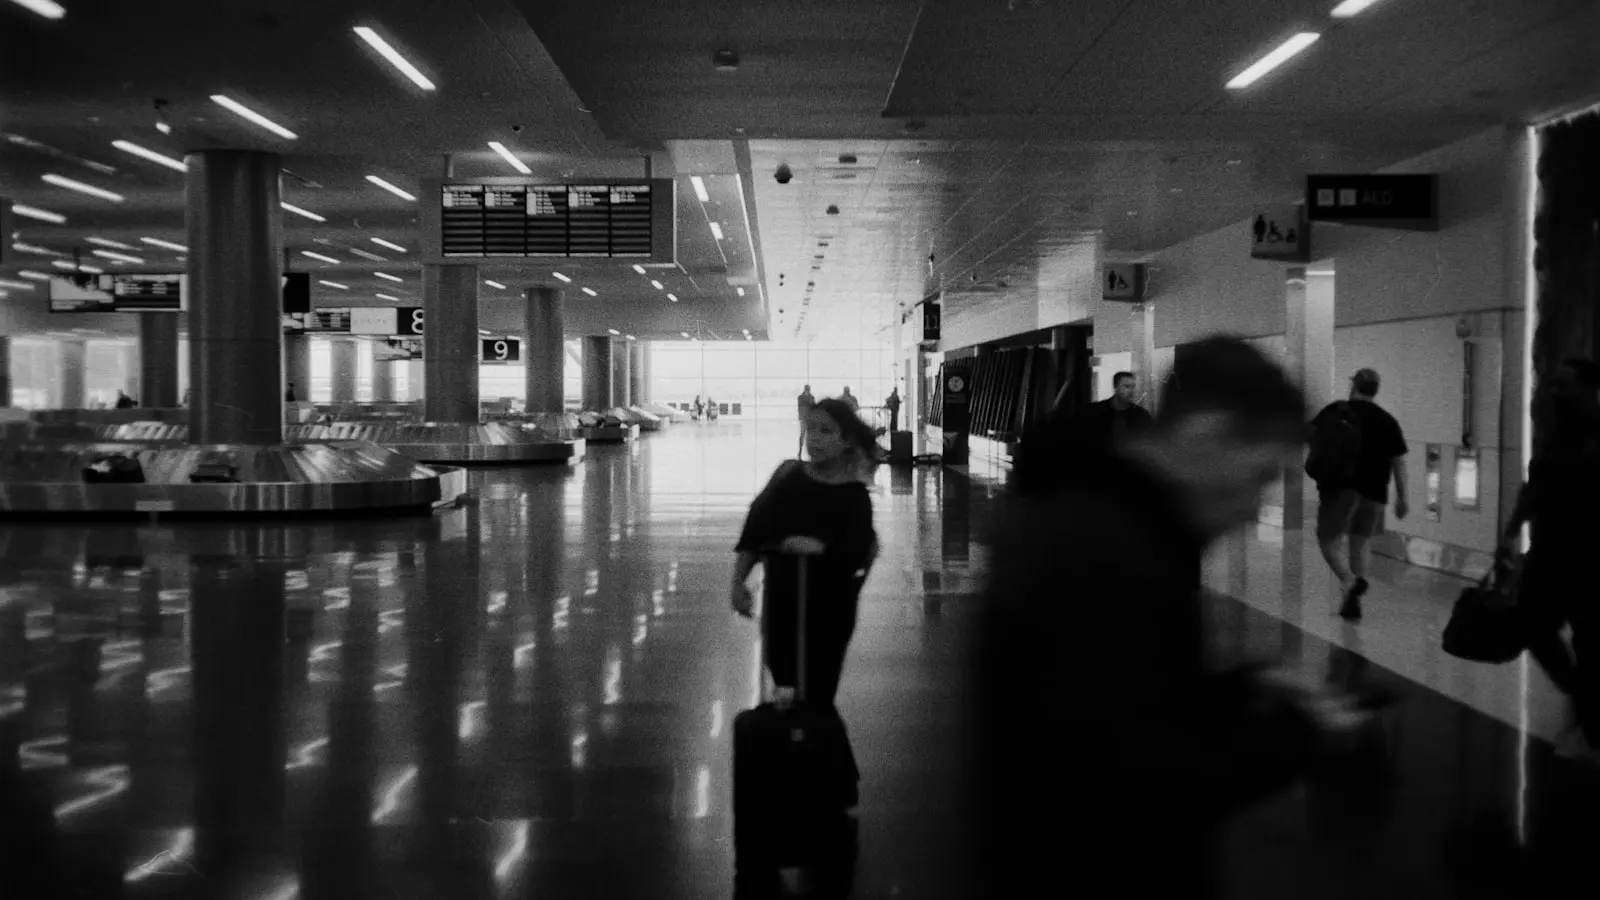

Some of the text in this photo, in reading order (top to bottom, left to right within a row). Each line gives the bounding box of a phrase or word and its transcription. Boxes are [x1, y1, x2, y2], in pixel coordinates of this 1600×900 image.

[1361, 188, 1394, 206] AED
[411, 309, 424, 334] 8
[494, 340, 508, 360] 9
